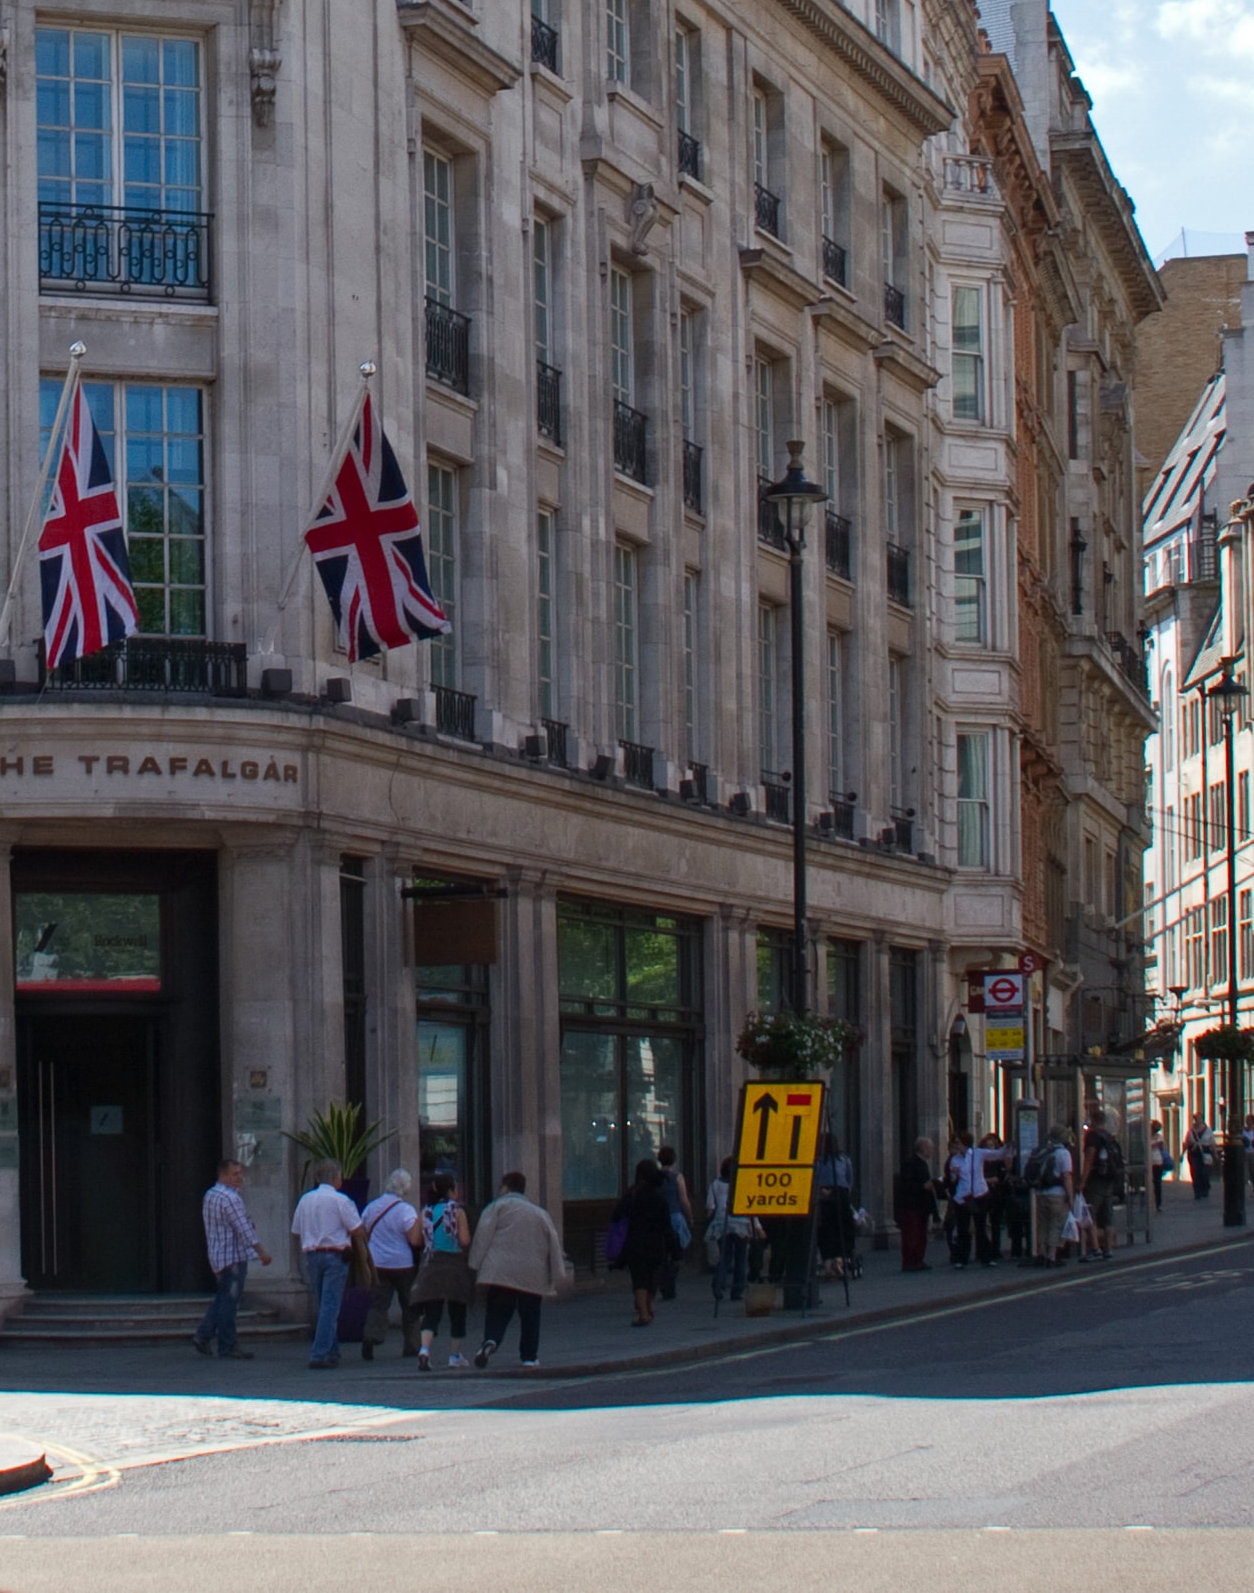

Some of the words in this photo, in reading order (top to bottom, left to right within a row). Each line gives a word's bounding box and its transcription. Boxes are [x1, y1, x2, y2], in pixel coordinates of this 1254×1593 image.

[78, 755, 299, 784] TRAFALGAR
[1023, 955, 1035, 971] S
[756, 1172, 792, 1187] 100
[746, 1191, 798, 1208] yards
